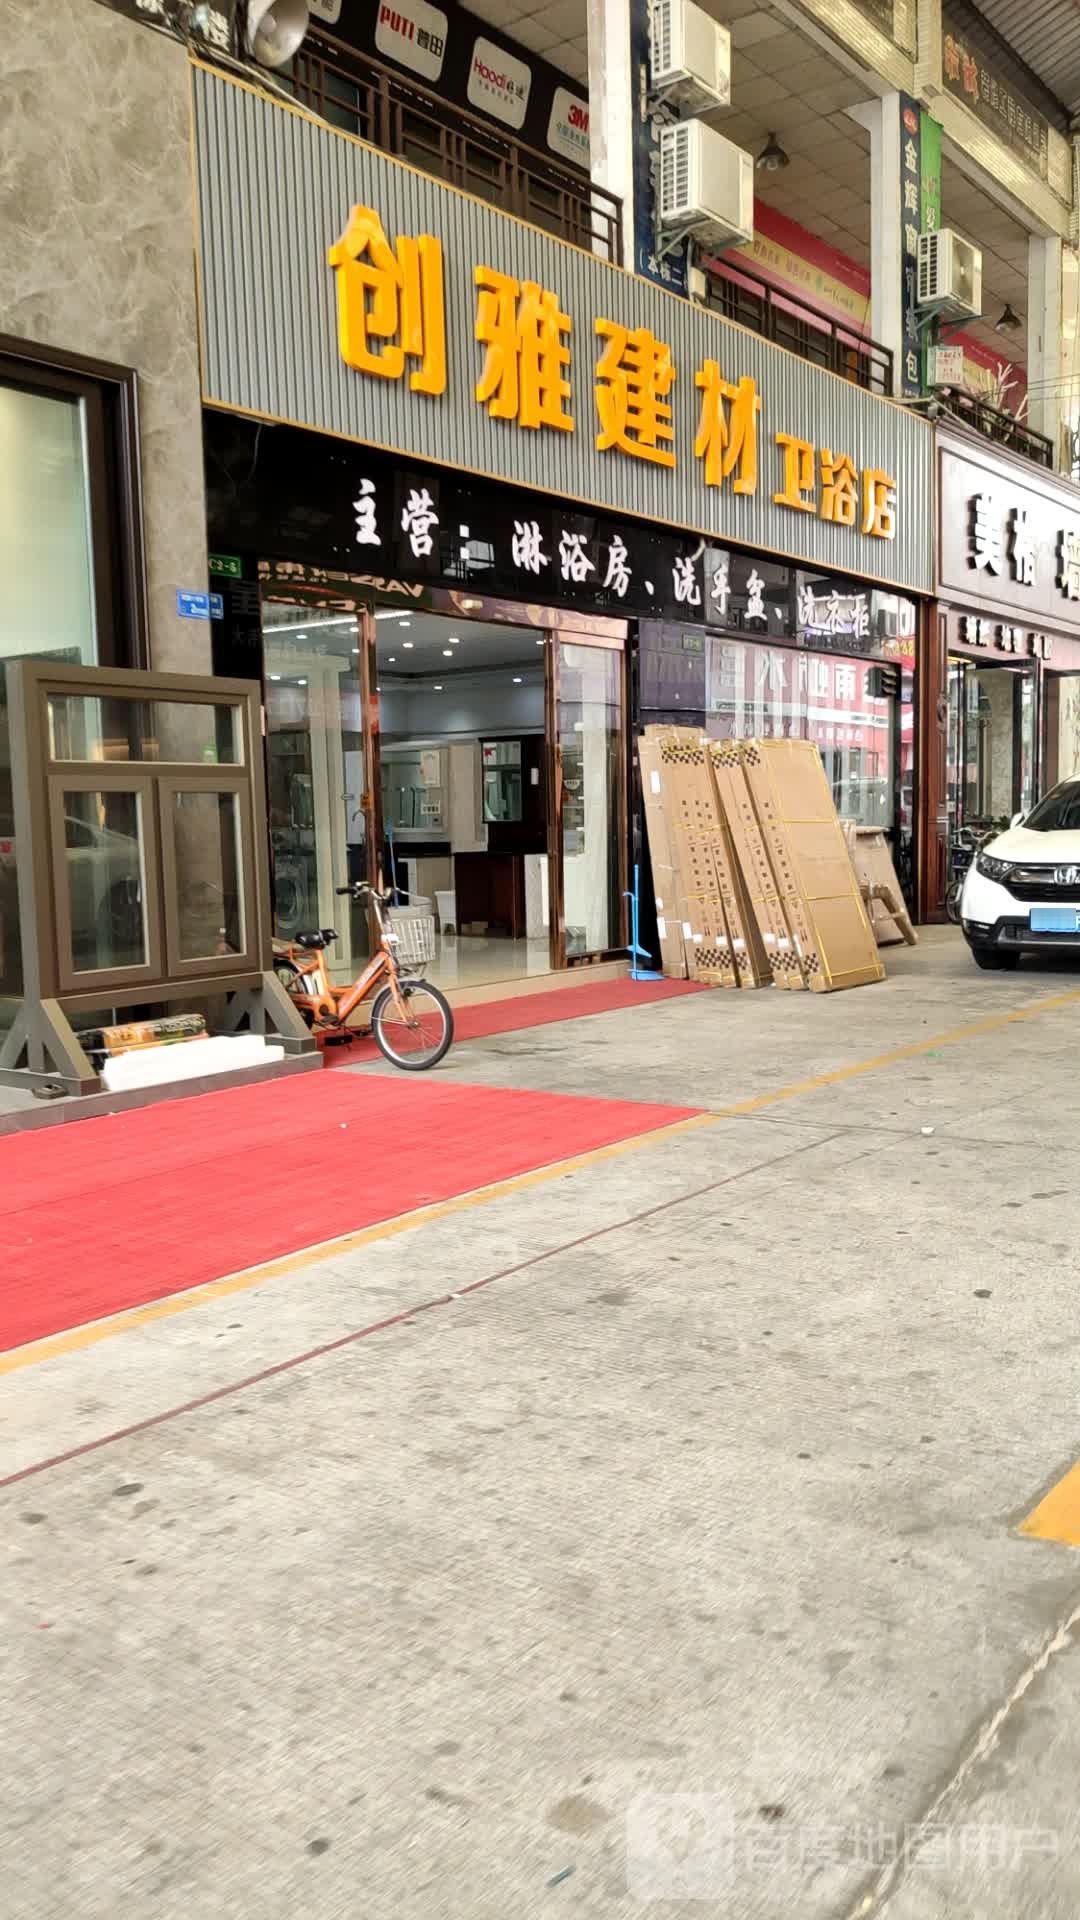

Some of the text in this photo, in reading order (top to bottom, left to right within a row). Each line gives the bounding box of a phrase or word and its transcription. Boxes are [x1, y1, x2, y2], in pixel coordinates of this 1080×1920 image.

[380, 4, 415, 41] PUTI
[328, 203, 898, 541] 创雅建材 卫浴店
